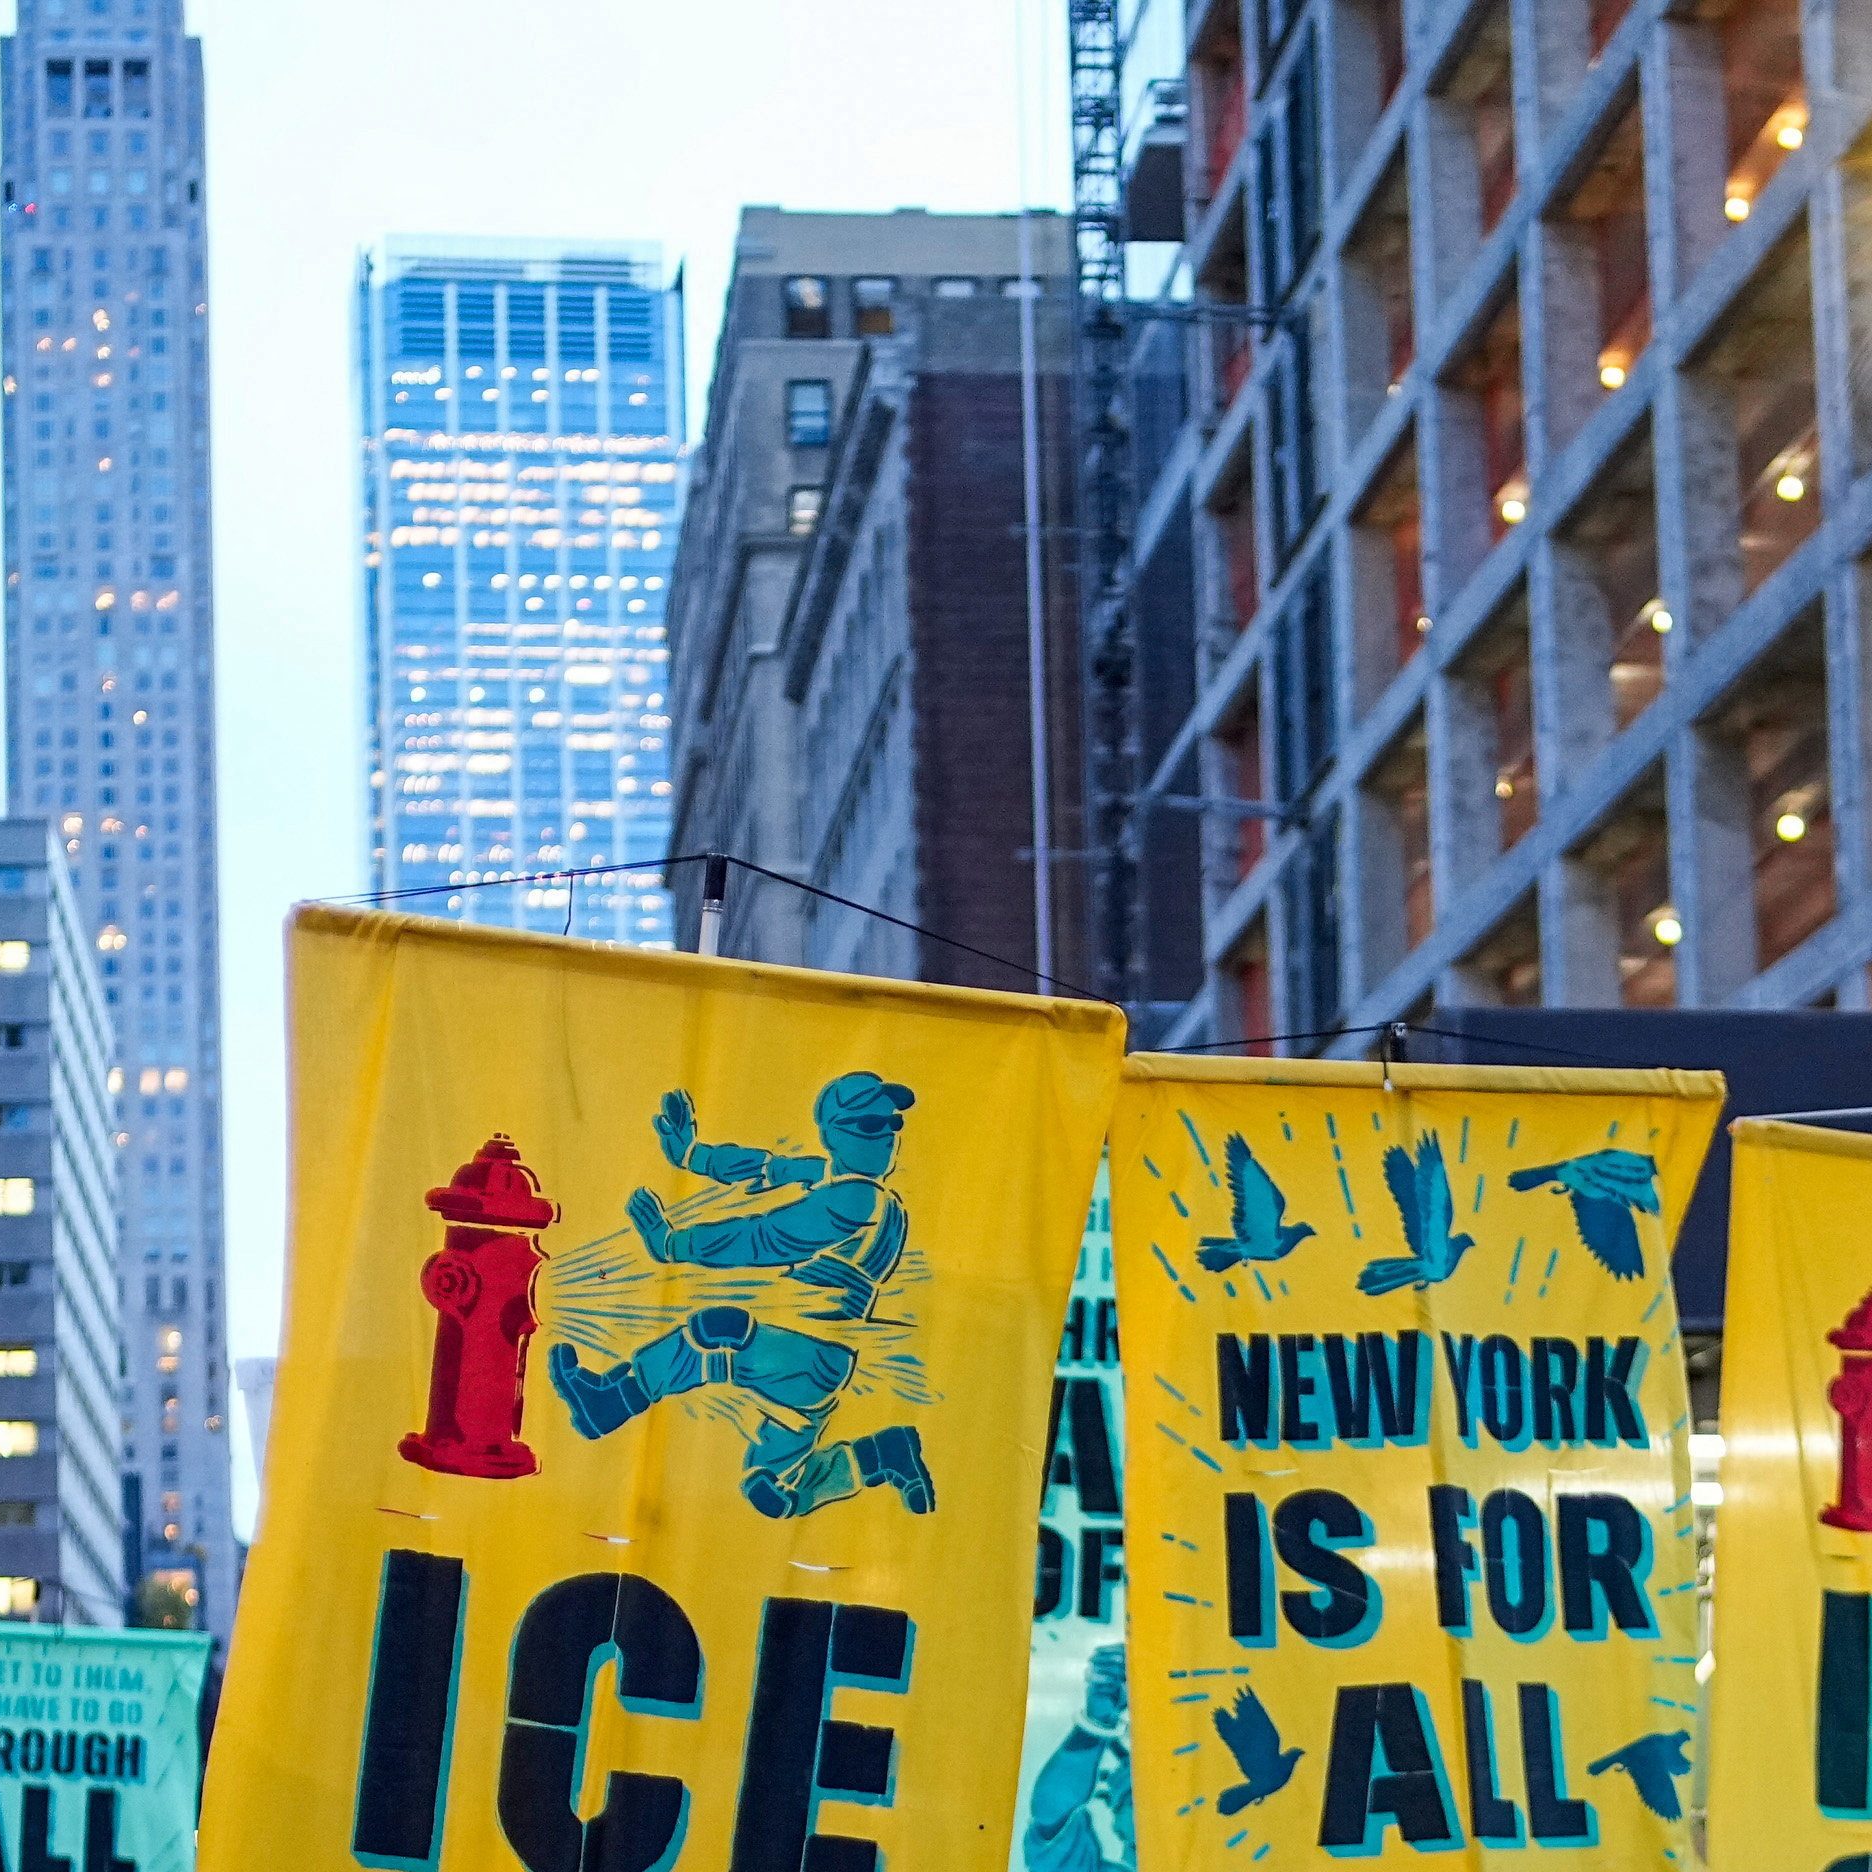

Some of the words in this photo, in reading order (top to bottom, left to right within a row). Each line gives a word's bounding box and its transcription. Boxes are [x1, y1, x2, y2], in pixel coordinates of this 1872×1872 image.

[1216, 1327, 1431, 1452] NEW
[1439, 1328, 1651, 1454] YORK
[1223, 1484, 1384, 1652] IS
[1426, 1480, 1662, 1645] FOR
[32, 1662, 62, 1688] TO
[71, 1700, 100, 1723] TO
[108, 1701, 144, 1724] GO
[1316, 1675, 1601, 1859] ALL
